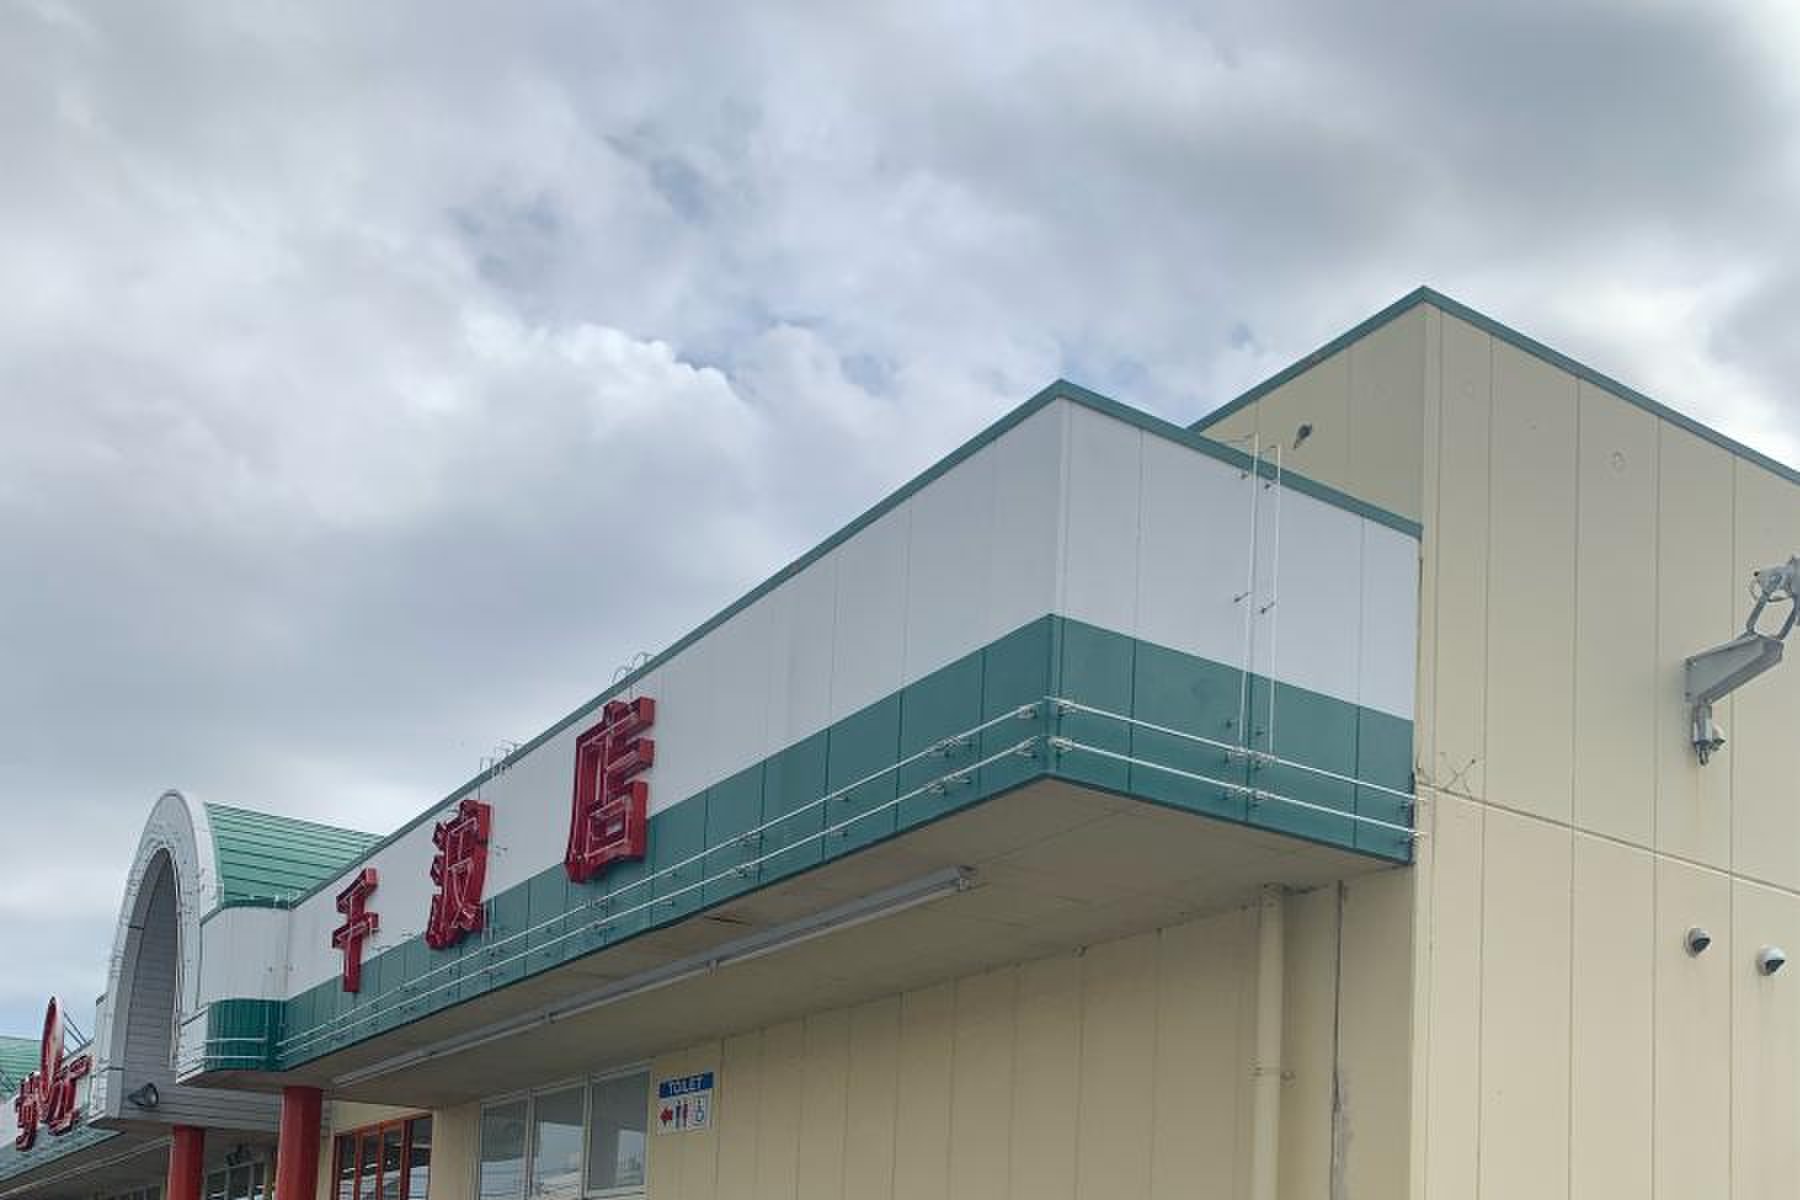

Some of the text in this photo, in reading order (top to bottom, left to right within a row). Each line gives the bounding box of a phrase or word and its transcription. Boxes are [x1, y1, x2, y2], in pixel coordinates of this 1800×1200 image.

[332, 696, 656, 993] 千波店
[668, 1076, 705, 1093] TOILET
